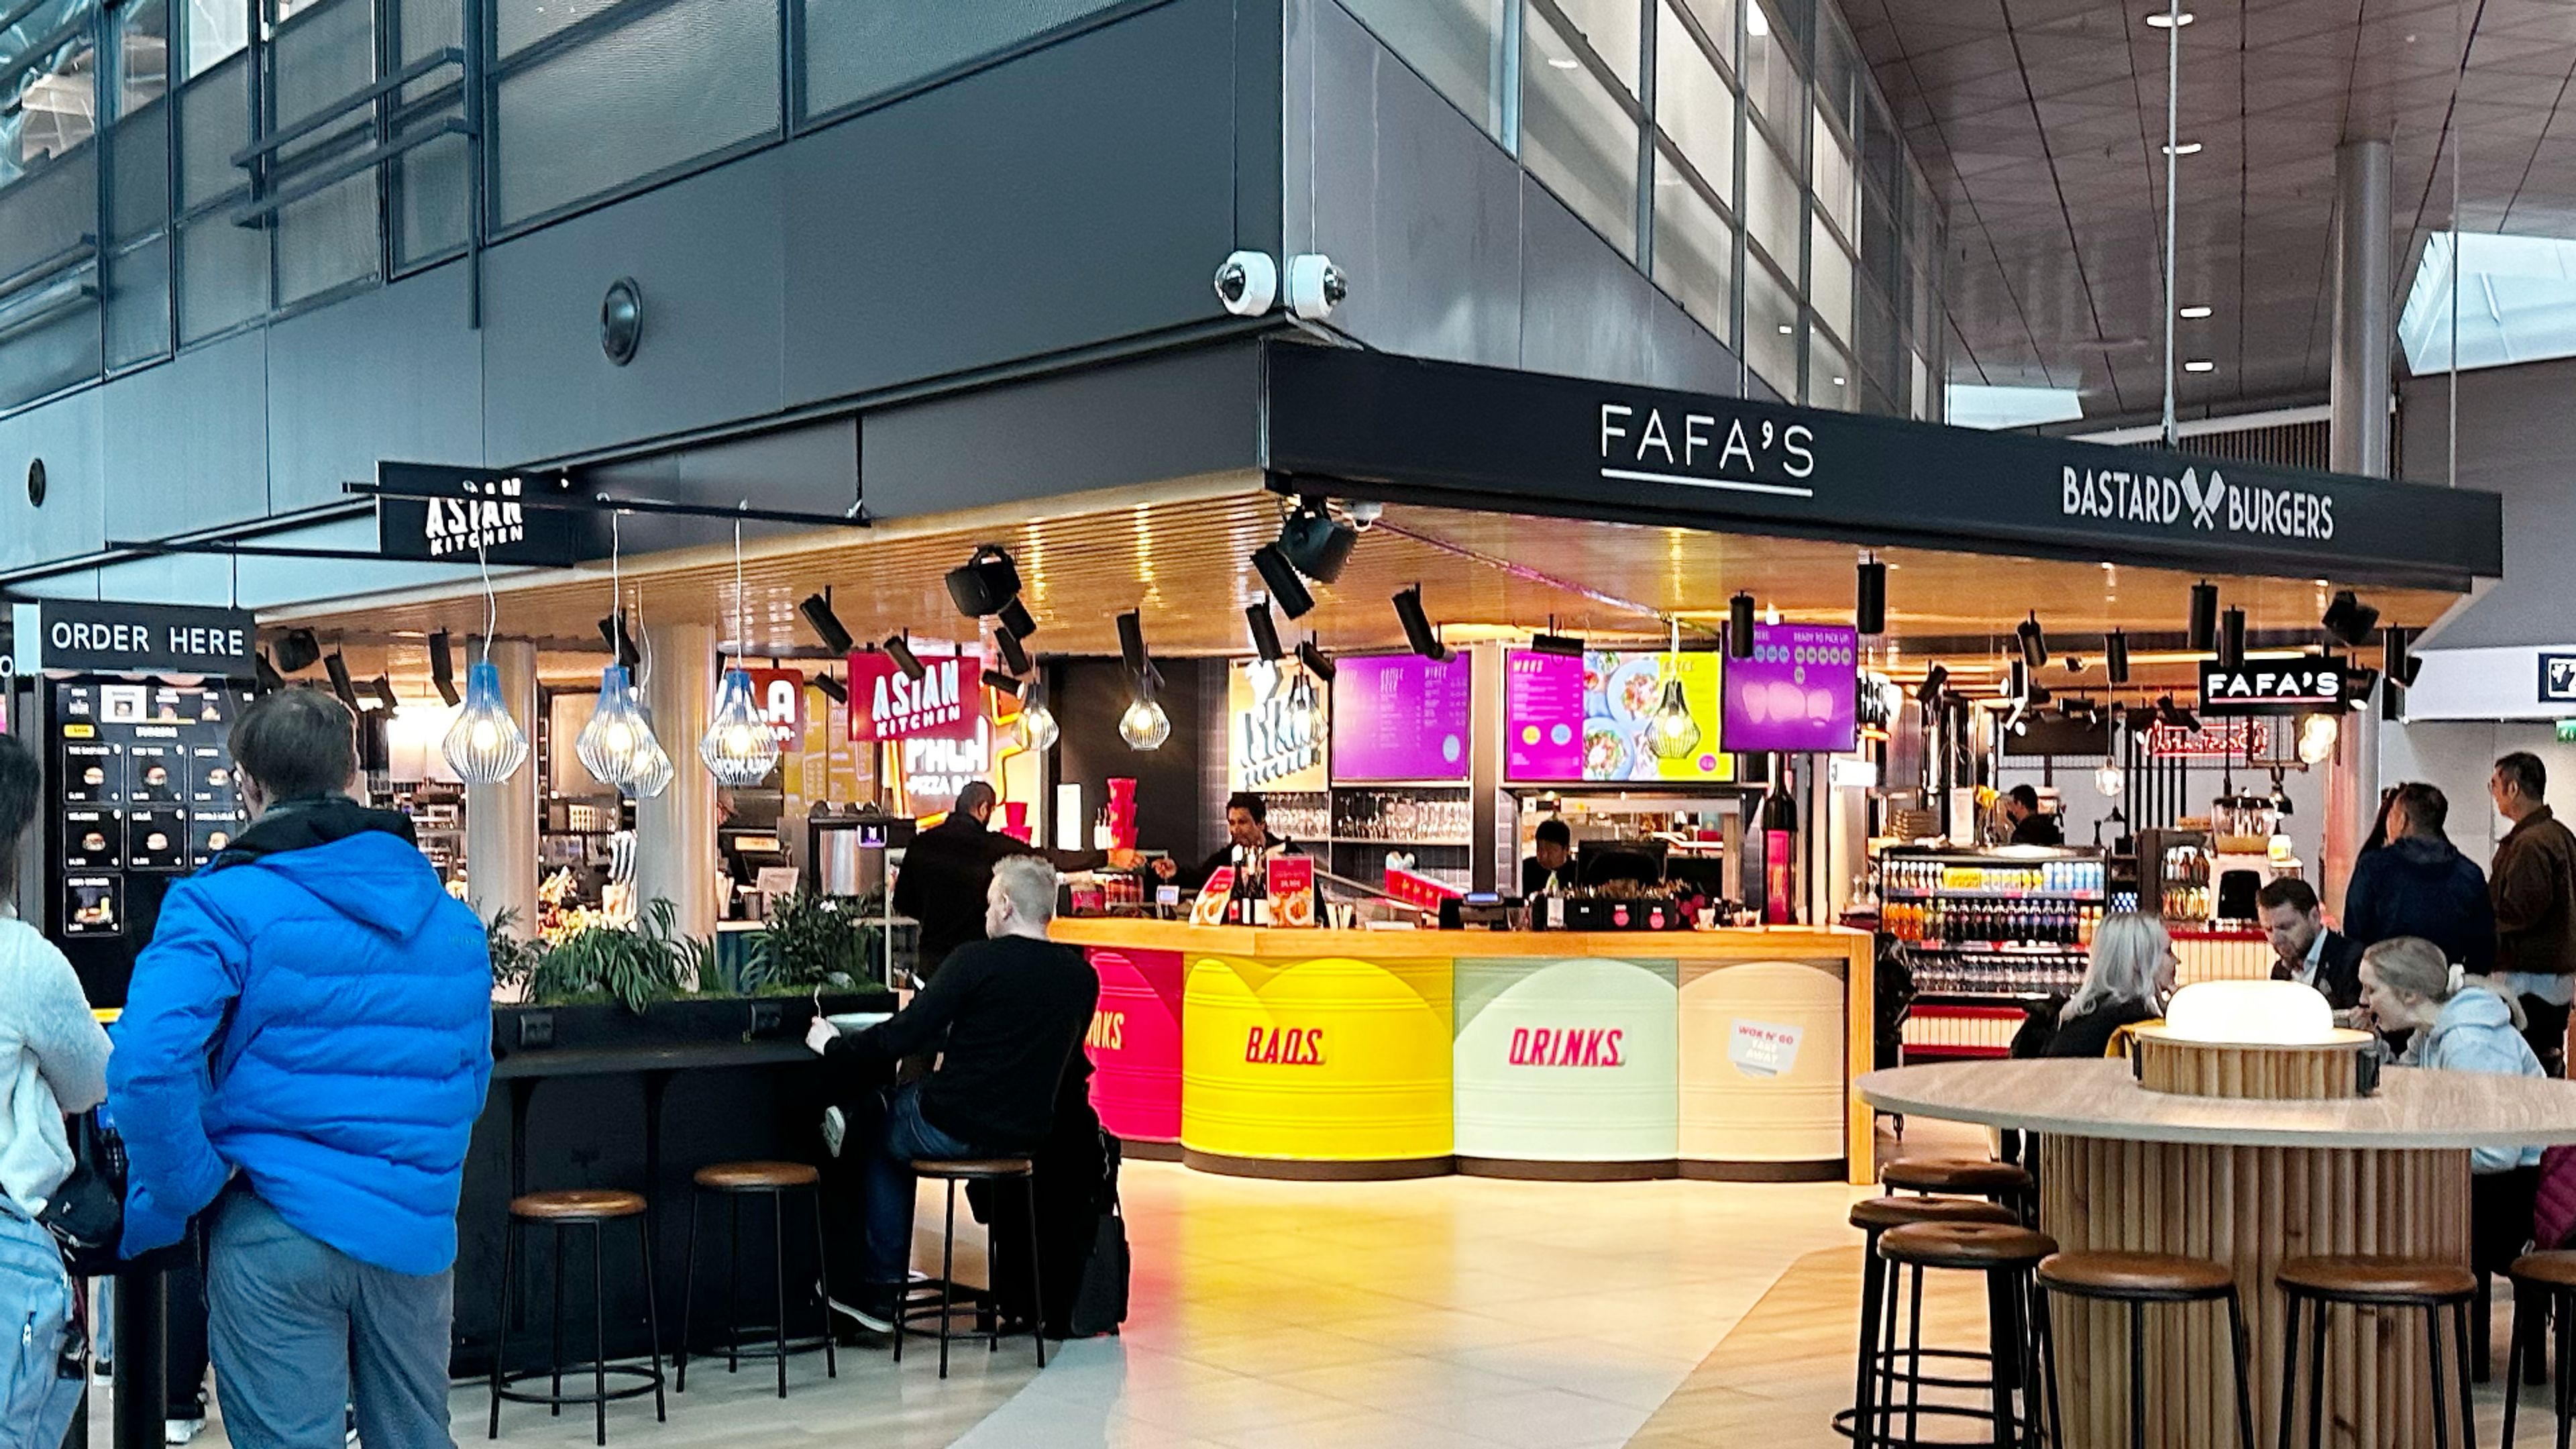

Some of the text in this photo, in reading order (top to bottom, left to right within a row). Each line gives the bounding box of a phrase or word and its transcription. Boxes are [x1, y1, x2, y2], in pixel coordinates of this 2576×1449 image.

[1601, 404, 1813, 478] FAFA'S
[425, 477, 523, 539] ASIAN
[2063, 466, 2334, 540] BASTARD BURGERS
[430, 525, 523, 556] KITCHEN
[52, 622, 244, 655] ORDER HERE
[872, 659, 960, 722] ASIAN
[2207, 671, 2339, 697] FAFA'S
[875, 704, 961, 739] KITCHEN
[1245, 1026, 1324, 1065] BAOS
[1509, 1026, 1623, 1067] DRINKS
